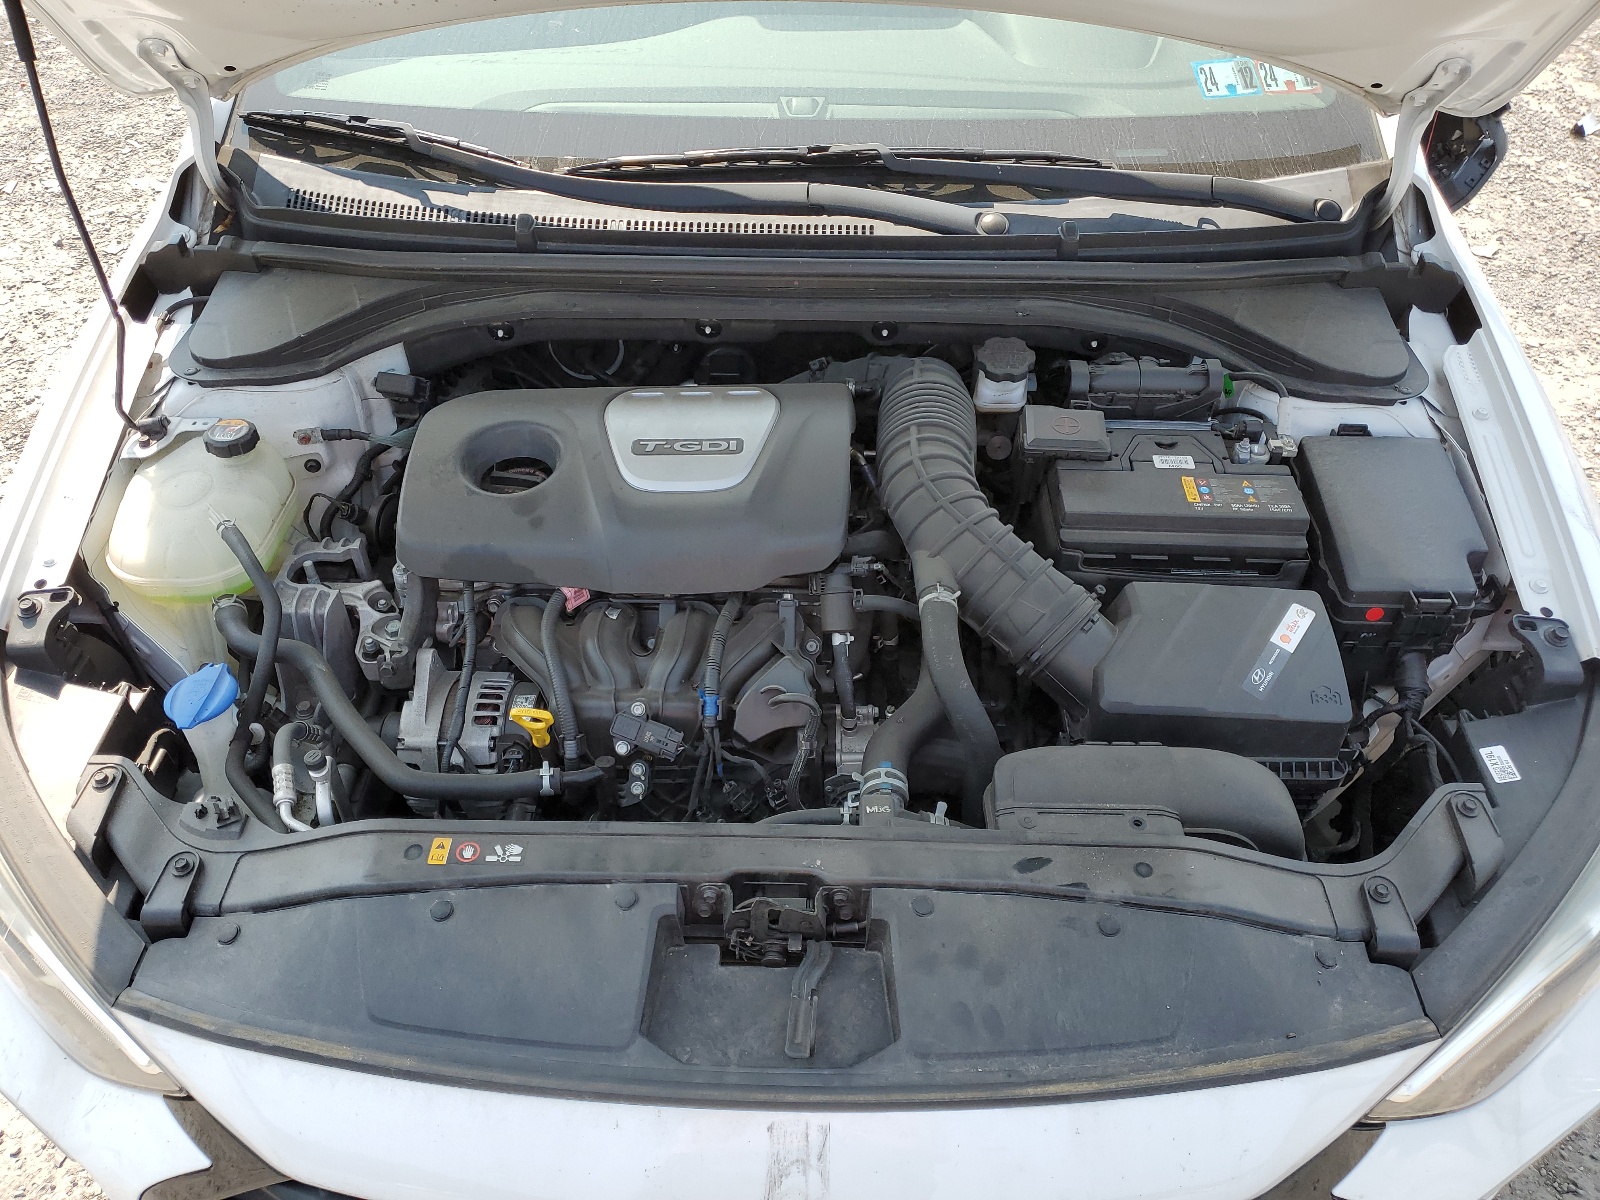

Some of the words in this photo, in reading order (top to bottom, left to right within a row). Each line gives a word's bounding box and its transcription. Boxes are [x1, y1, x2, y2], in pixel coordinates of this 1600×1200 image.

[1199, 66, 1220, 93] 24
[1237, 66, 1258, 90] 12
[1259, 62, 1279, 88] 24
[640, 440, 737, 452] T-GDI
